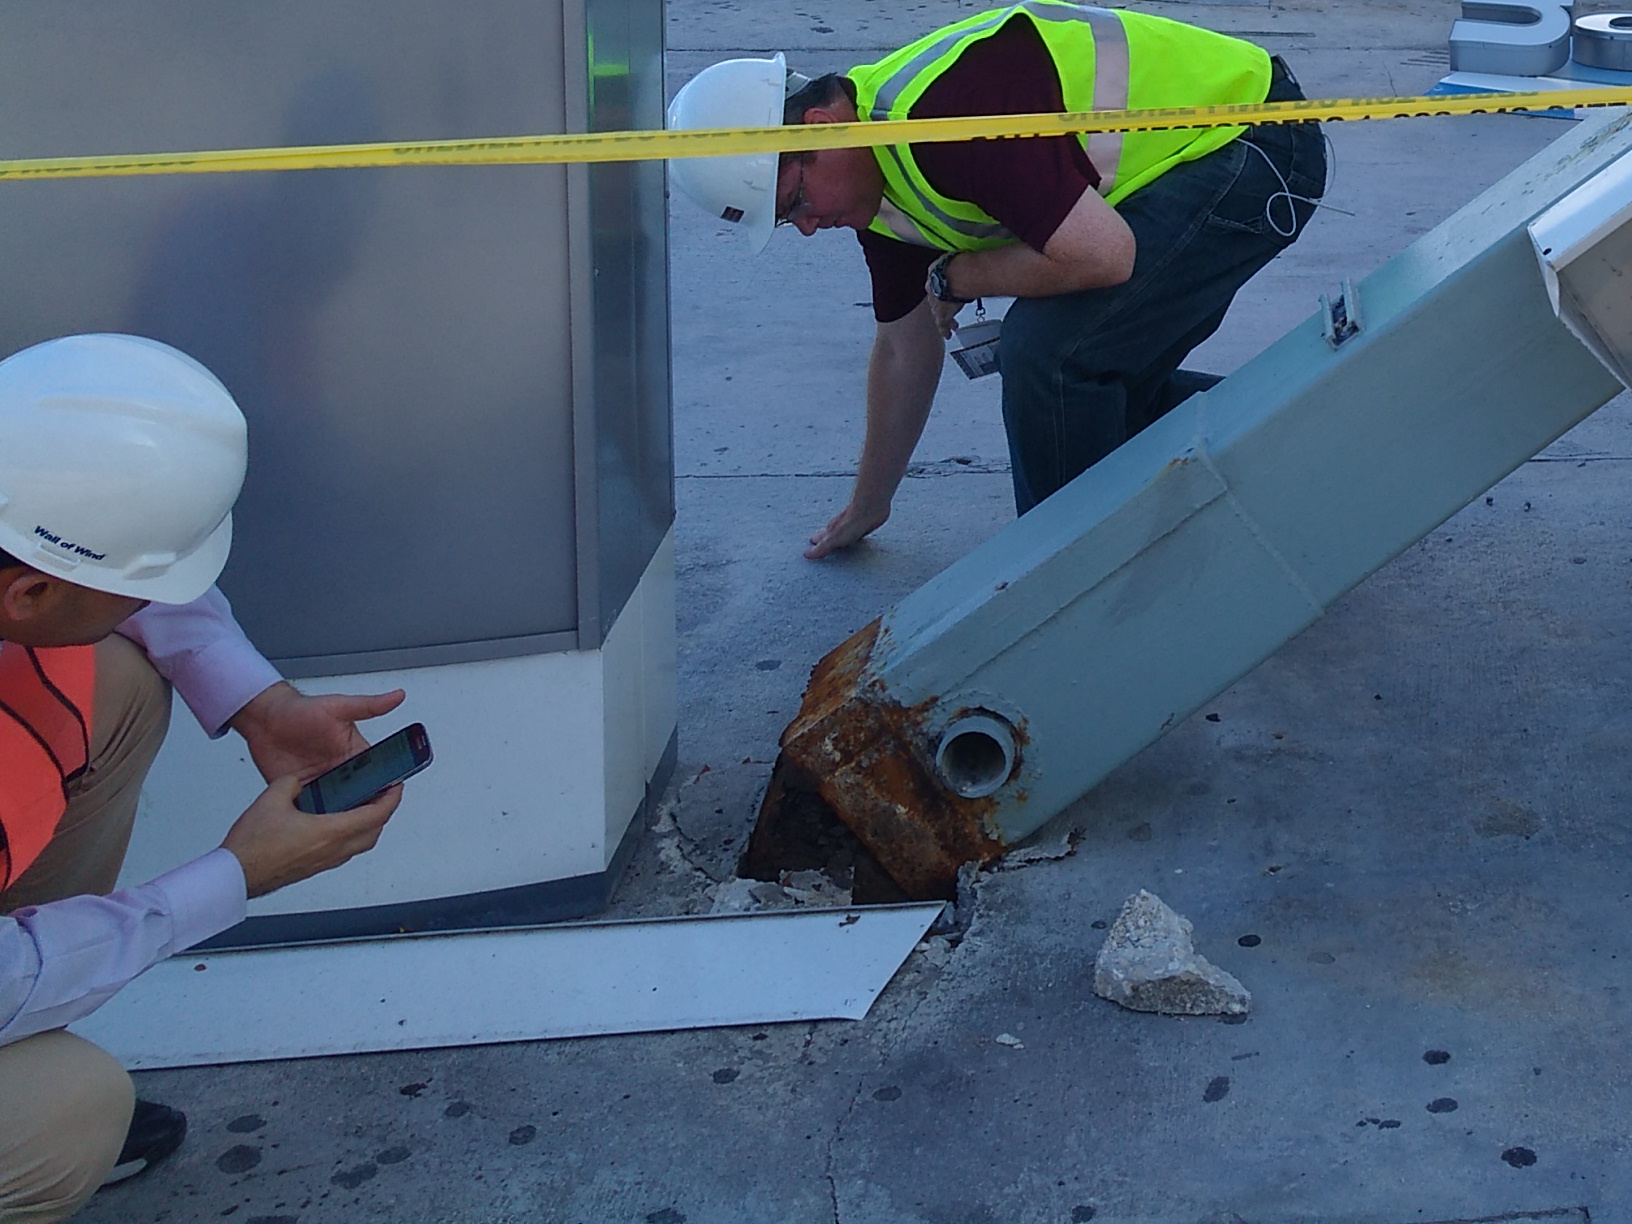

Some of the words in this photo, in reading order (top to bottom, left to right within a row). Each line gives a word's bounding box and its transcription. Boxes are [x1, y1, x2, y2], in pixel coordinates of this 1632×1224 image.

[34, 525, 61, 544] Wall
[60, 542, 76, 550] of
[74, 546, 106, 561] Wind
